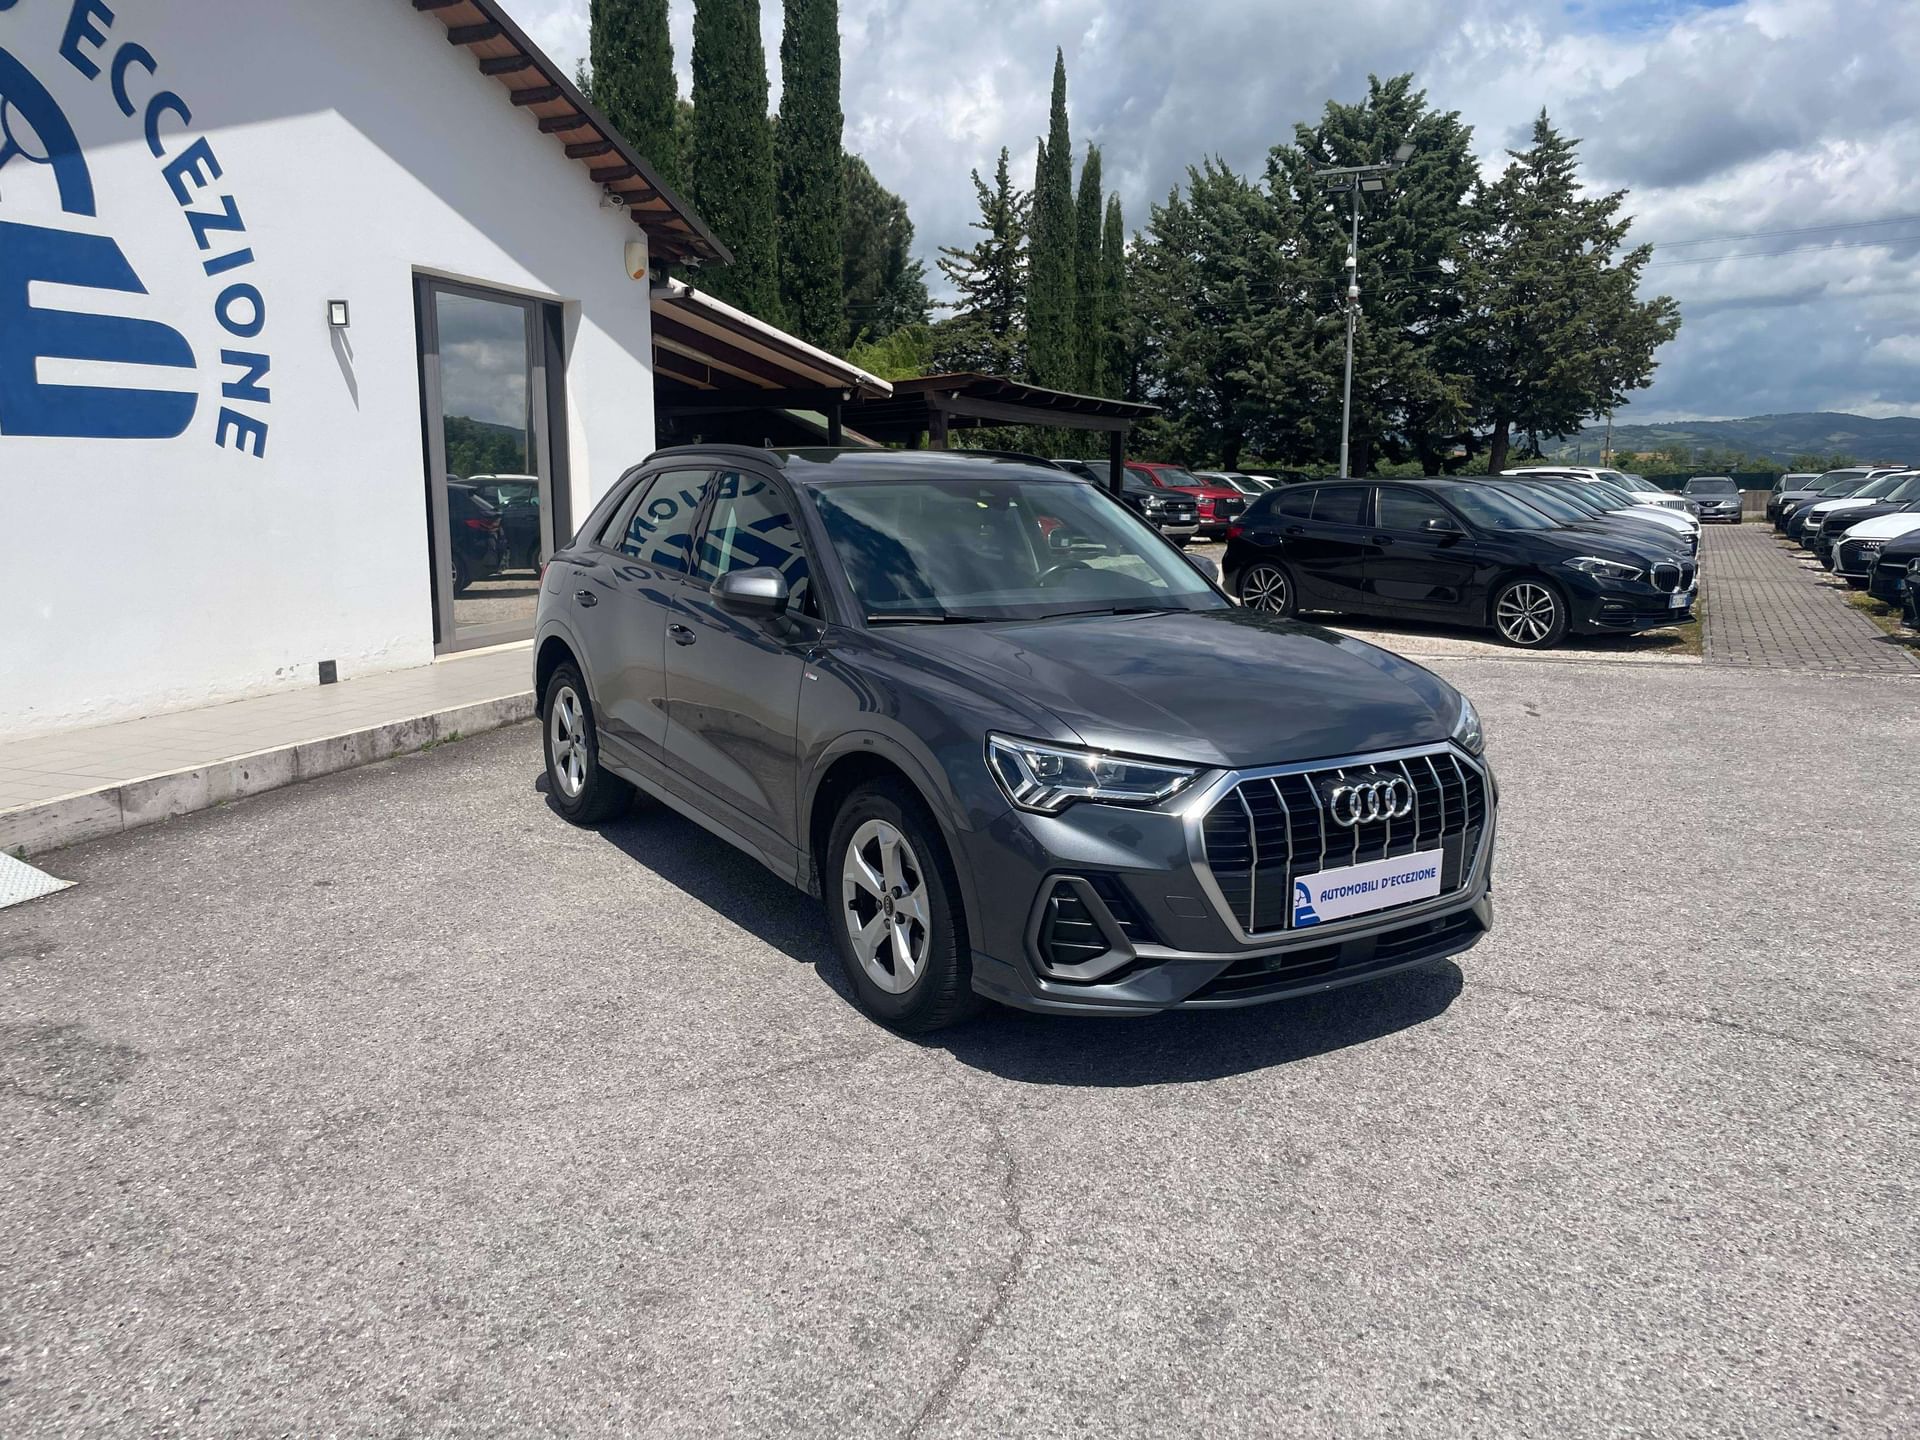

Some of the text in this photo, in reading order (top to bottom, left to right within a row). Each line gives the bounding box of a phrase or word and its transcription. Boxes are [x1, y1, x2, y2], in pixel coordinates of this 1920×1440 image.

[0, 0, 271, 459] ECCEZIONE
[1320, 867, 1436, 902] AUTOMOBILI D'ECCEZIONE
